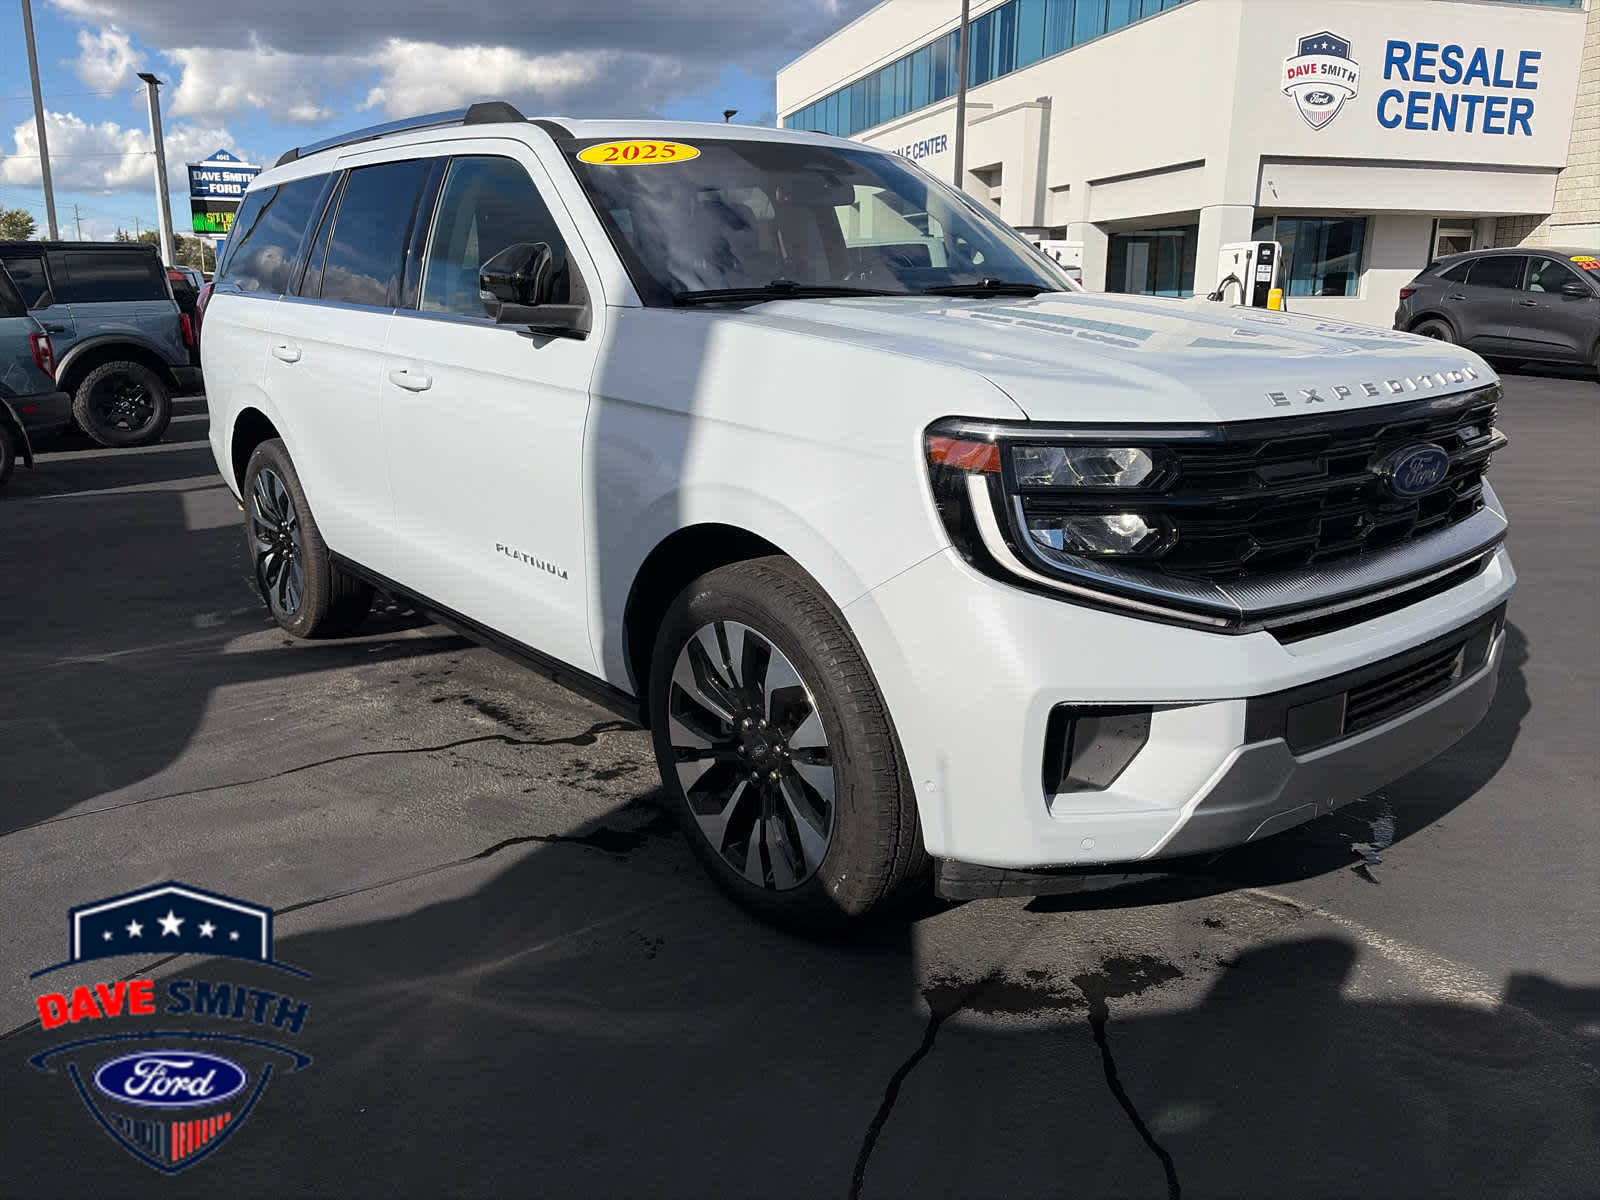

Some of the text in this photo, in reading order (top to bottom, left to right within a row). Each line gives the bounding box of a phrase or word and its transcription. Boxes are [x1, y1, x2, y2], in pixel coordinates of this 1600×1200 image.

[1287, 64, 1356, 83] DAVE SMITH
[1383, 40, 1542, 90] RESALE
[1309, 92, 1330, 104] Ford
[1376, 89, 1535, 136] CENTER
[602, 145, 676, 162] 2025
[912, 134, 948, 159] CENTER
[193, 171, 254, 182] DAVE SMITH
[209, 184, 241, 193] FORD
[1265, 366, 1479, 407] EXPEDITION
[1404, 455, 1441, 488] Ford
[496, 543, 568, 580] PLATINUM
